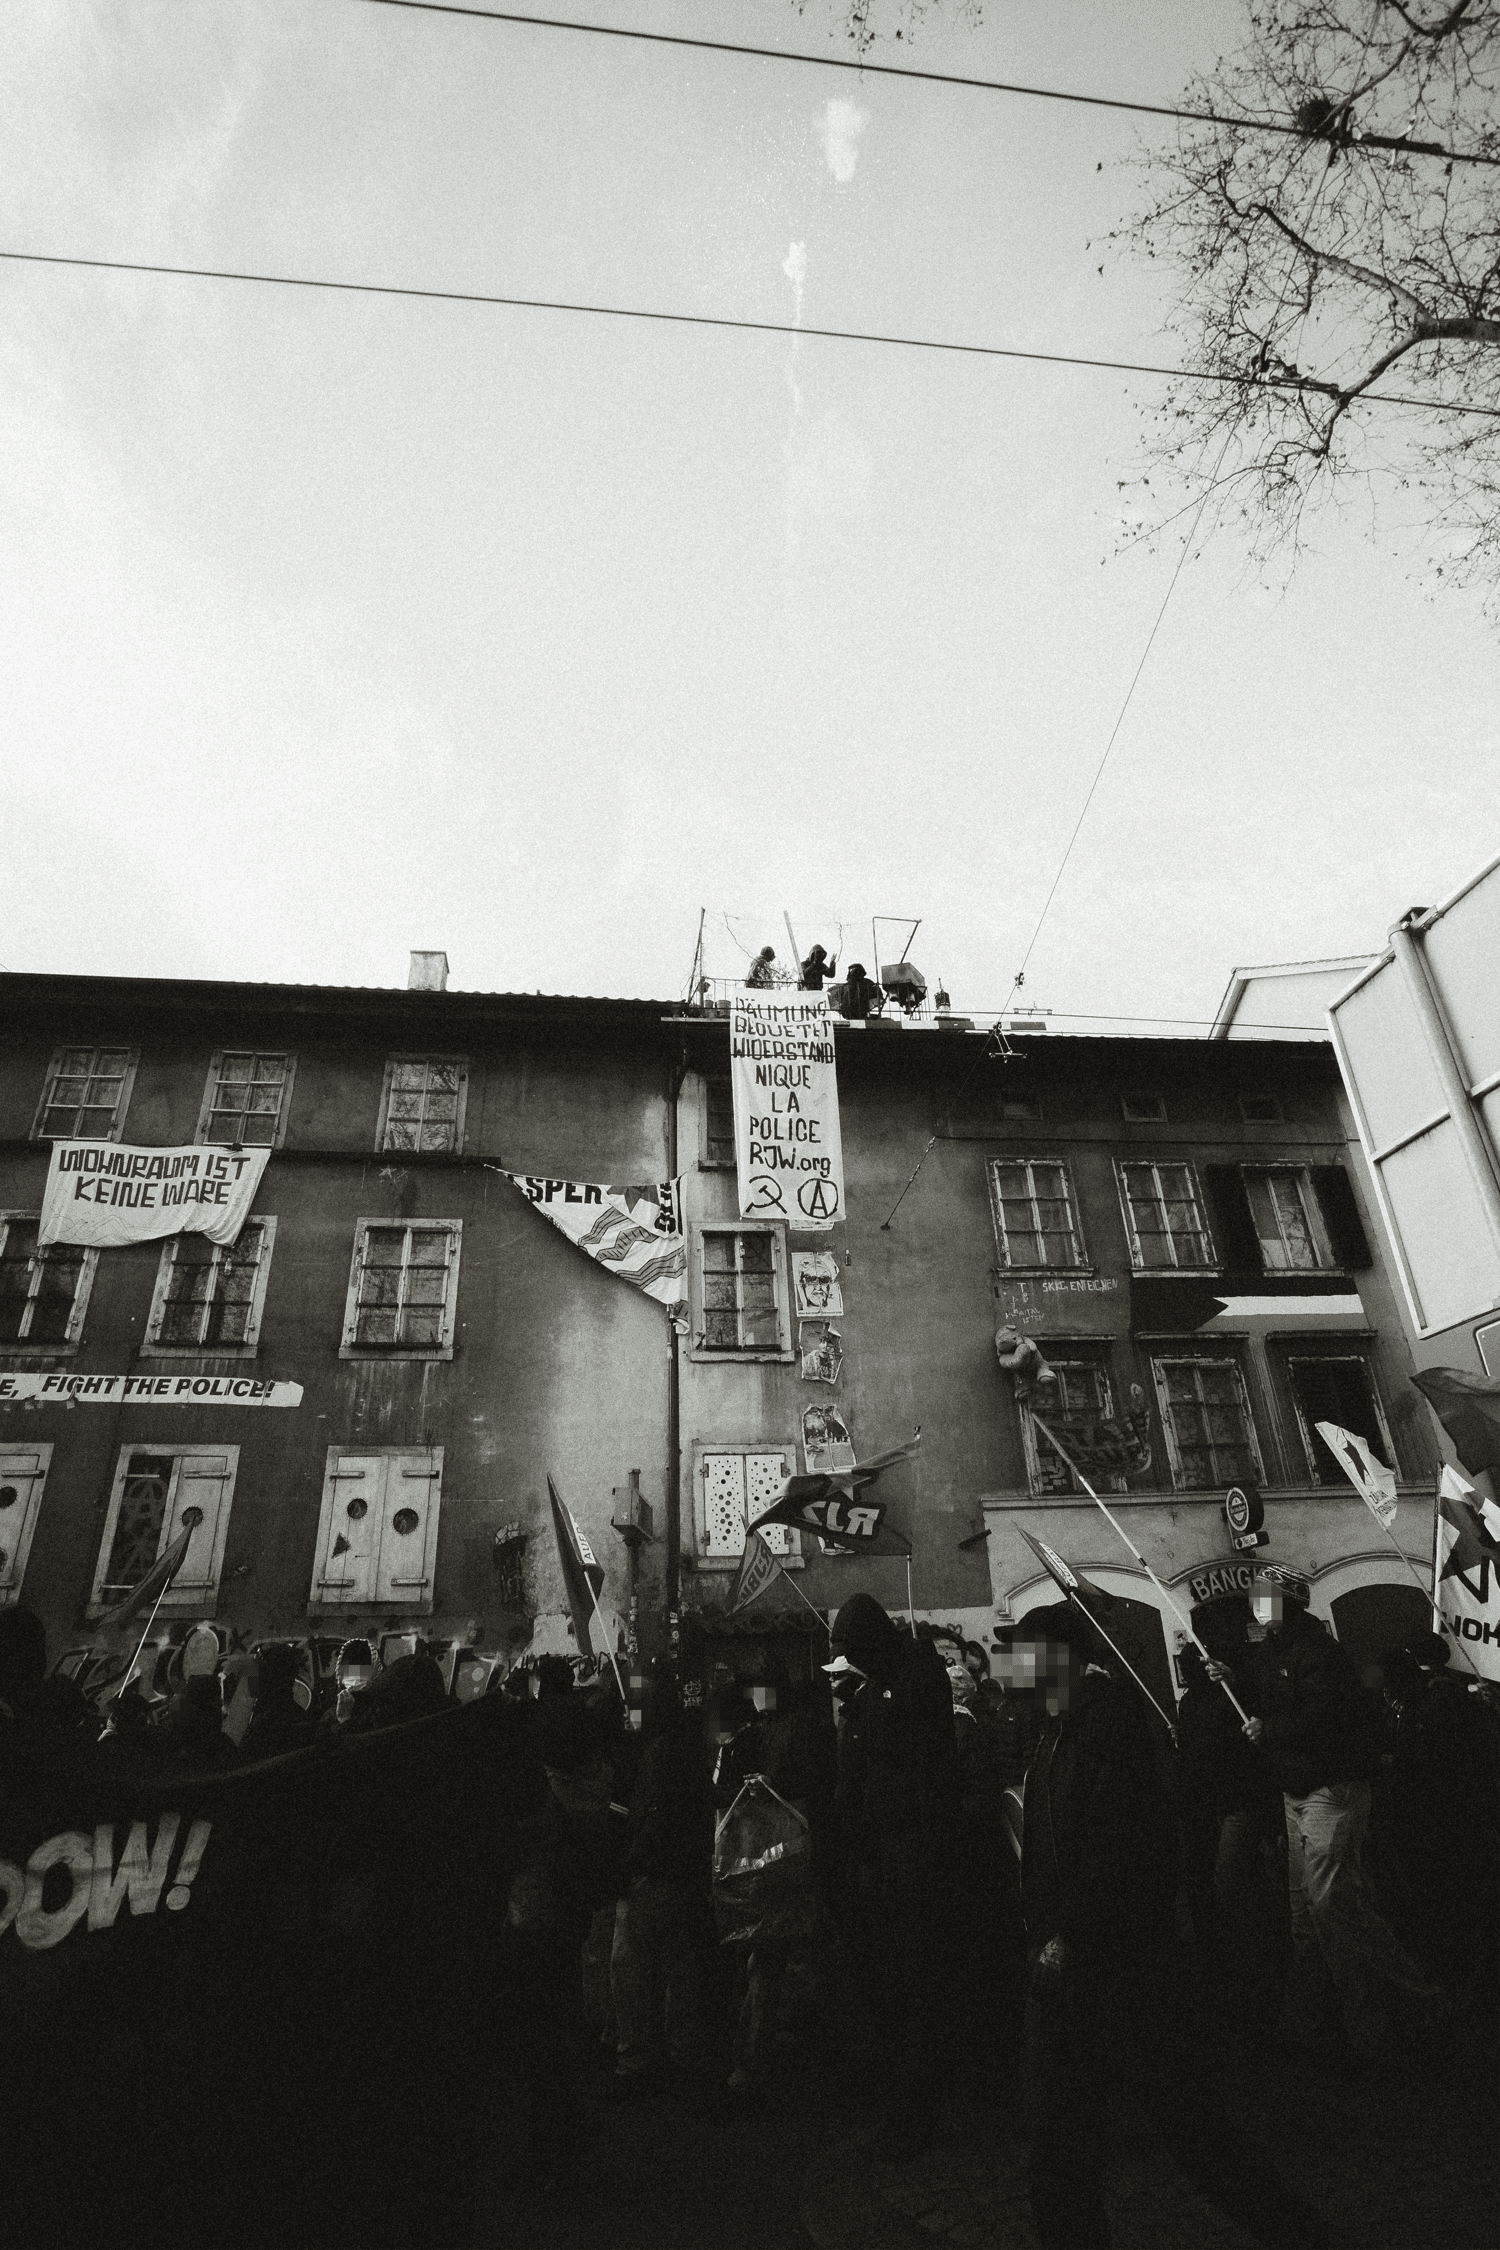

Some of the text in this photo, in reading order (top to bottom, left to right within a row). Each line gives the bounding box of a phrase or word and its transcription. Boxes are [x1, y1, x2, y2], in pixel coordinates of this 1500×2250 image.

[733, 1038, 834, 1064] WIDERSTAND
[755, 1064, 811, 1089] NIQUE
[772, 1091, 800, 1113] LA
[750, 1115, 821, 1143] POLICE
[59, 1149, 250, 1180] WOHNRAUM IST
[750, 1142, 832, 1178] RJW.org
[74, 1176, 232, 1208] KEINE WARE
[42, 1376, 119, 1393] FIGHT
[124, 1379, 175, 1395] THE
[174, 1378, 275, 1398] POLICE!
